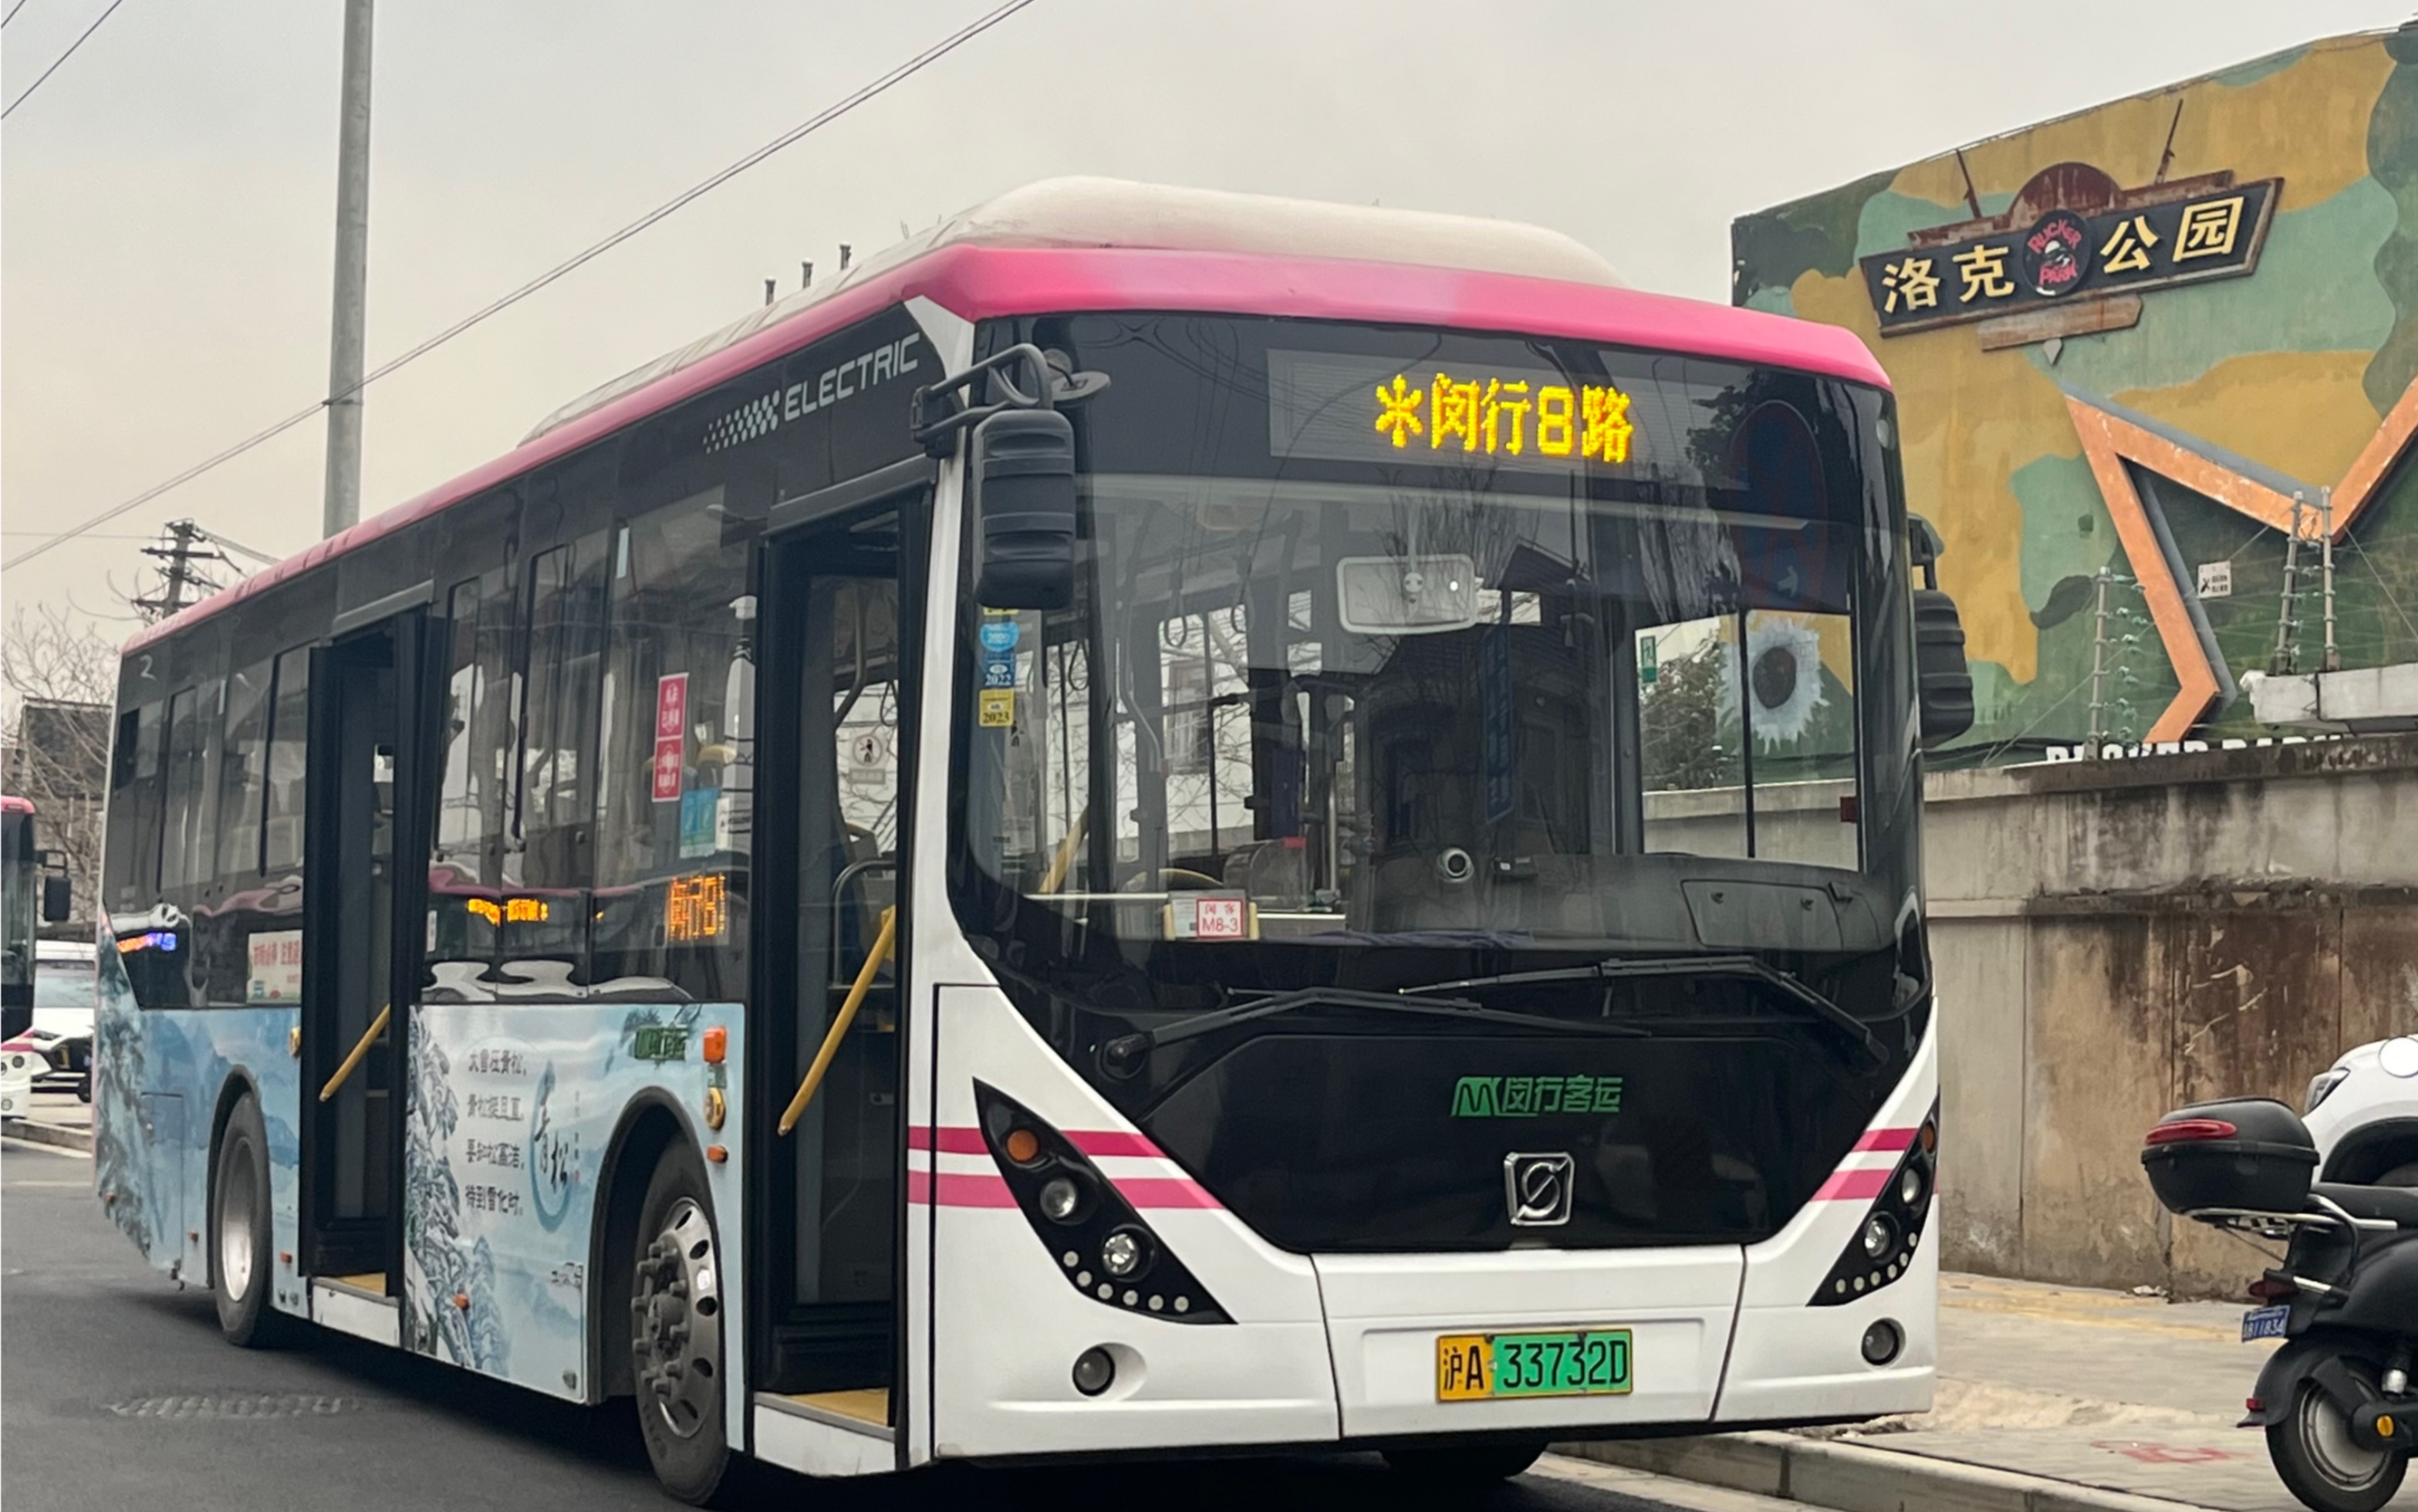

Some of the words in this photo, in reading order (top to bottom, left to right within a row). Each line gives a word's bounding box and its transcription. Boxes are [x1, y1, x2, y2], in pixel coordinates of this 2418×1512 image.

[2027, 218, 2082, 255] RUCKER
[784, 332, 920, 422] ELECTRIC
[984, 673, 1012, 687] 2022
[982, 710, 1011, 724] 2023
[1201, 917, 1238, 932] M8-3
